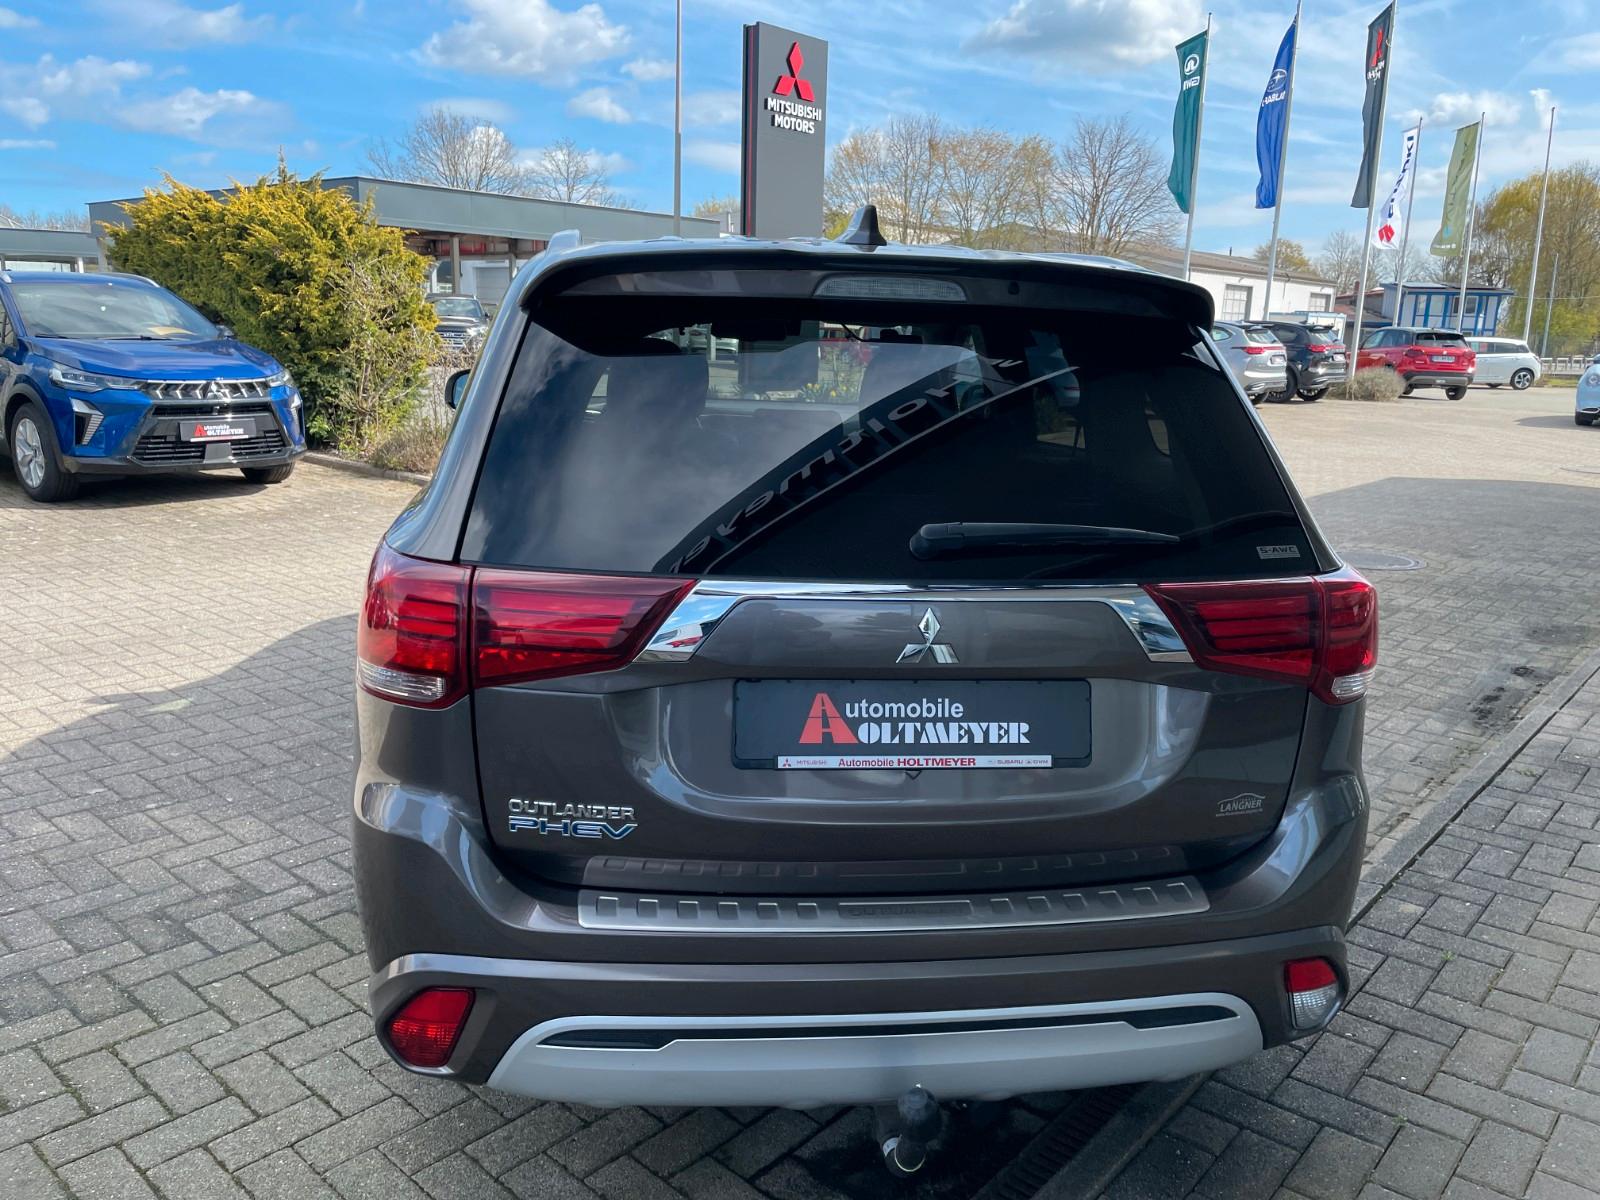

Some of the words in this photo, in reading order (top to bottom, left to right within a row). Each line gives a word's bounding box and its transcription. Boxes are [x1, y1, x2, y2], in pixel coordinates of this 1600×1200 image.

[766, 97, 822, 121] MITSUBISHI
[773, 113, 815, 134] MOTORS
[838, 758, 894, 767] Automobile
[897, 757, 977, 766] HOLTMEYER
[508, 798, 635, 821] OUTLANDER
[1219, 799, 1263, 813] LANGNER
[508, 815, 639, 840] PHEV
